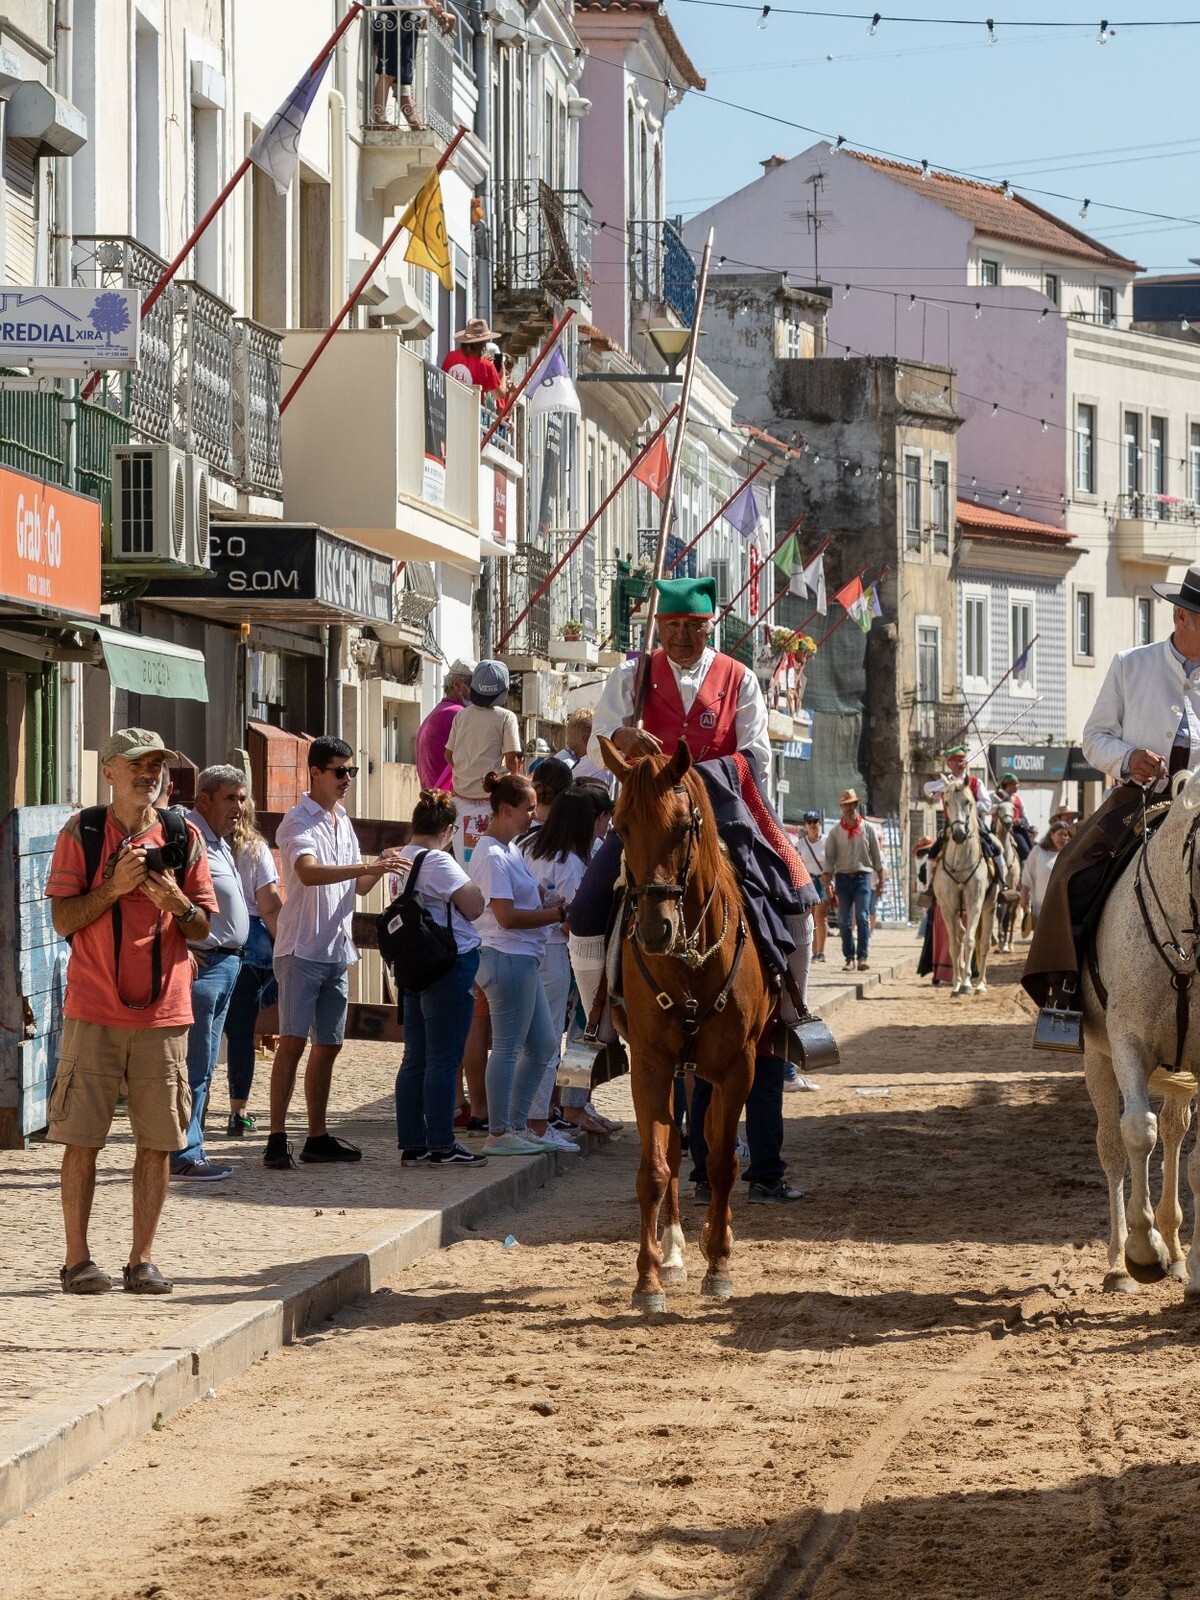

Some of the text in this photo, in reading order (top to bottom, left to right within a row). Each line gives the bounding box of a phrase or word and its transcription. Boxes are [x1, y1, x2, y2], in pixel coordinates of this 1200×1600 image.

[0, 322, 103, 343] REDIAL XIRA
[16, 493, 41, 563] Grab
[48, 504, 62, 569] Go
[478, 682, 499, 692] VANS
[1014, 754, 1046, 771] CONSTANT
